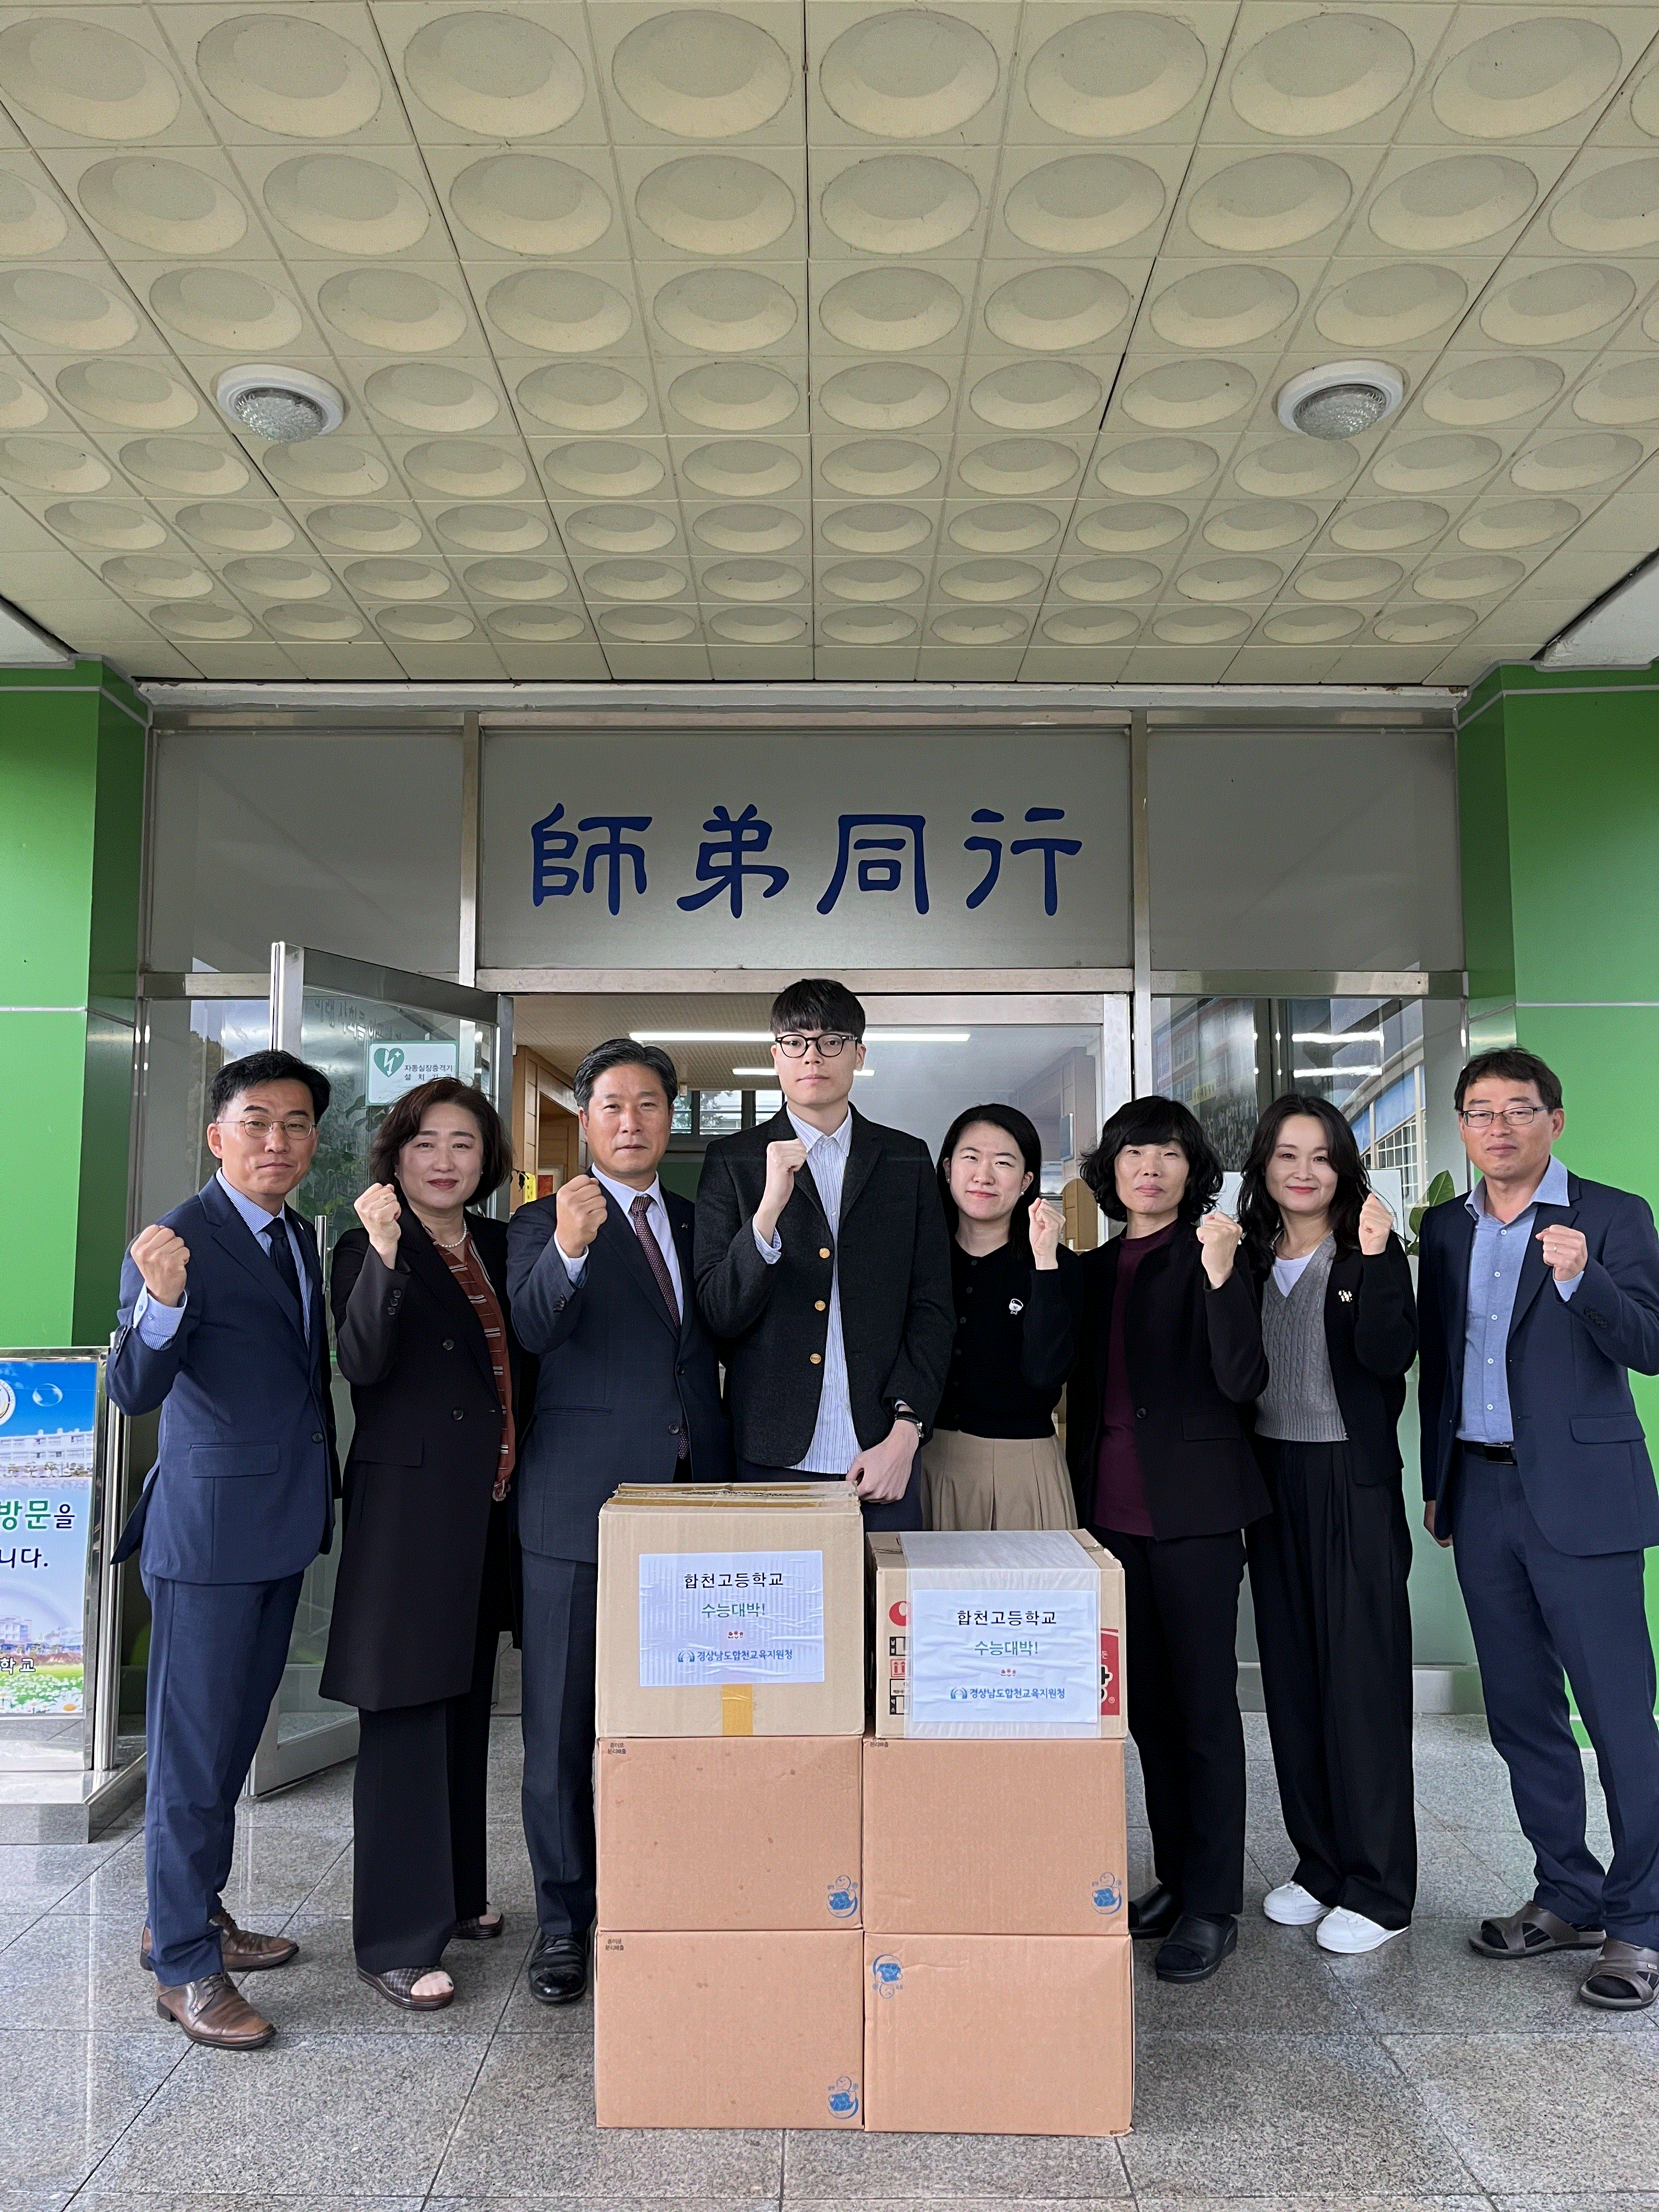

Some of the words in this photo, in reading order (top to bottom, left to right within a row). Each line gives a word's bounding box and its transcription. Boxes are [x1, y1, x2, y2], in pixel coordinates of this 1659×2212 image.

[0, 1500, 76, 1531] 방문을
[684, 1572, 783, 1589] 합천고등학교
[701, 1602, 765, 1618] 수능대박!
[957, 1610, 1057, 1626] 합천고등학교
[697, 1649, 793, 1662] 경상남도합천교육지원청
[974, 1641, 1039, 1656] 수능대박!
[969, 1688, 1065, 1700] 경상남도합천교육지원청
